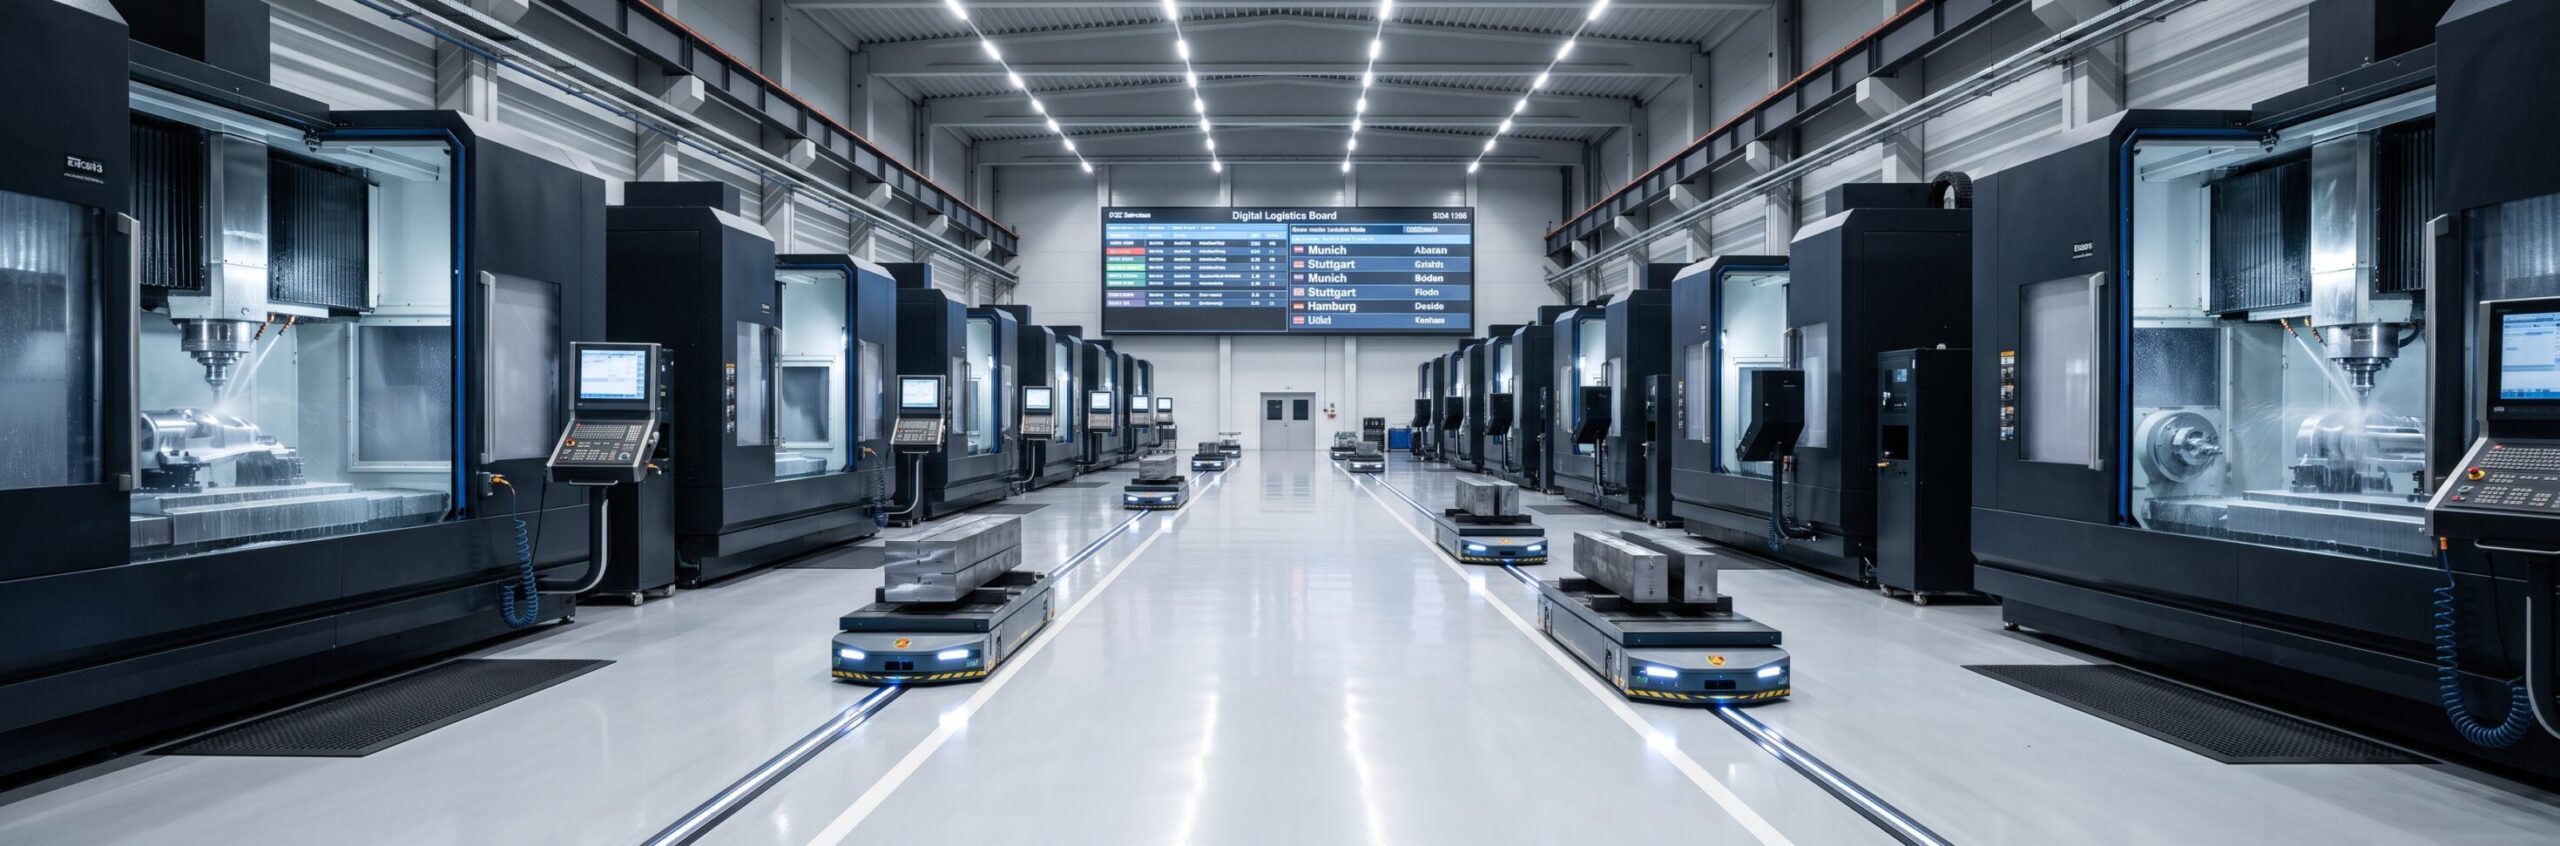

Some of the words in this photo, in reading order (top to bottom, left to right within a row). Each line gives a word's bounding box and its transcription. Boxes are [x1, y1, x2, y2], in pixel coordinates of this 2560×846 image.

[1232, 211, 1263, 222] Digital
[1265, 211, 1306, 222] Logistics
[1309, 211, 1337, 220] Board
[1308, 245, 1347, 255] Munich
[1308, 260, 1355, 271] Stuttgart
[1308, 273, 1347, 283] Munich
[1308, 287, 1356, 299] Stuttgart
[1308, 301, 1357, 313] Hamburg
